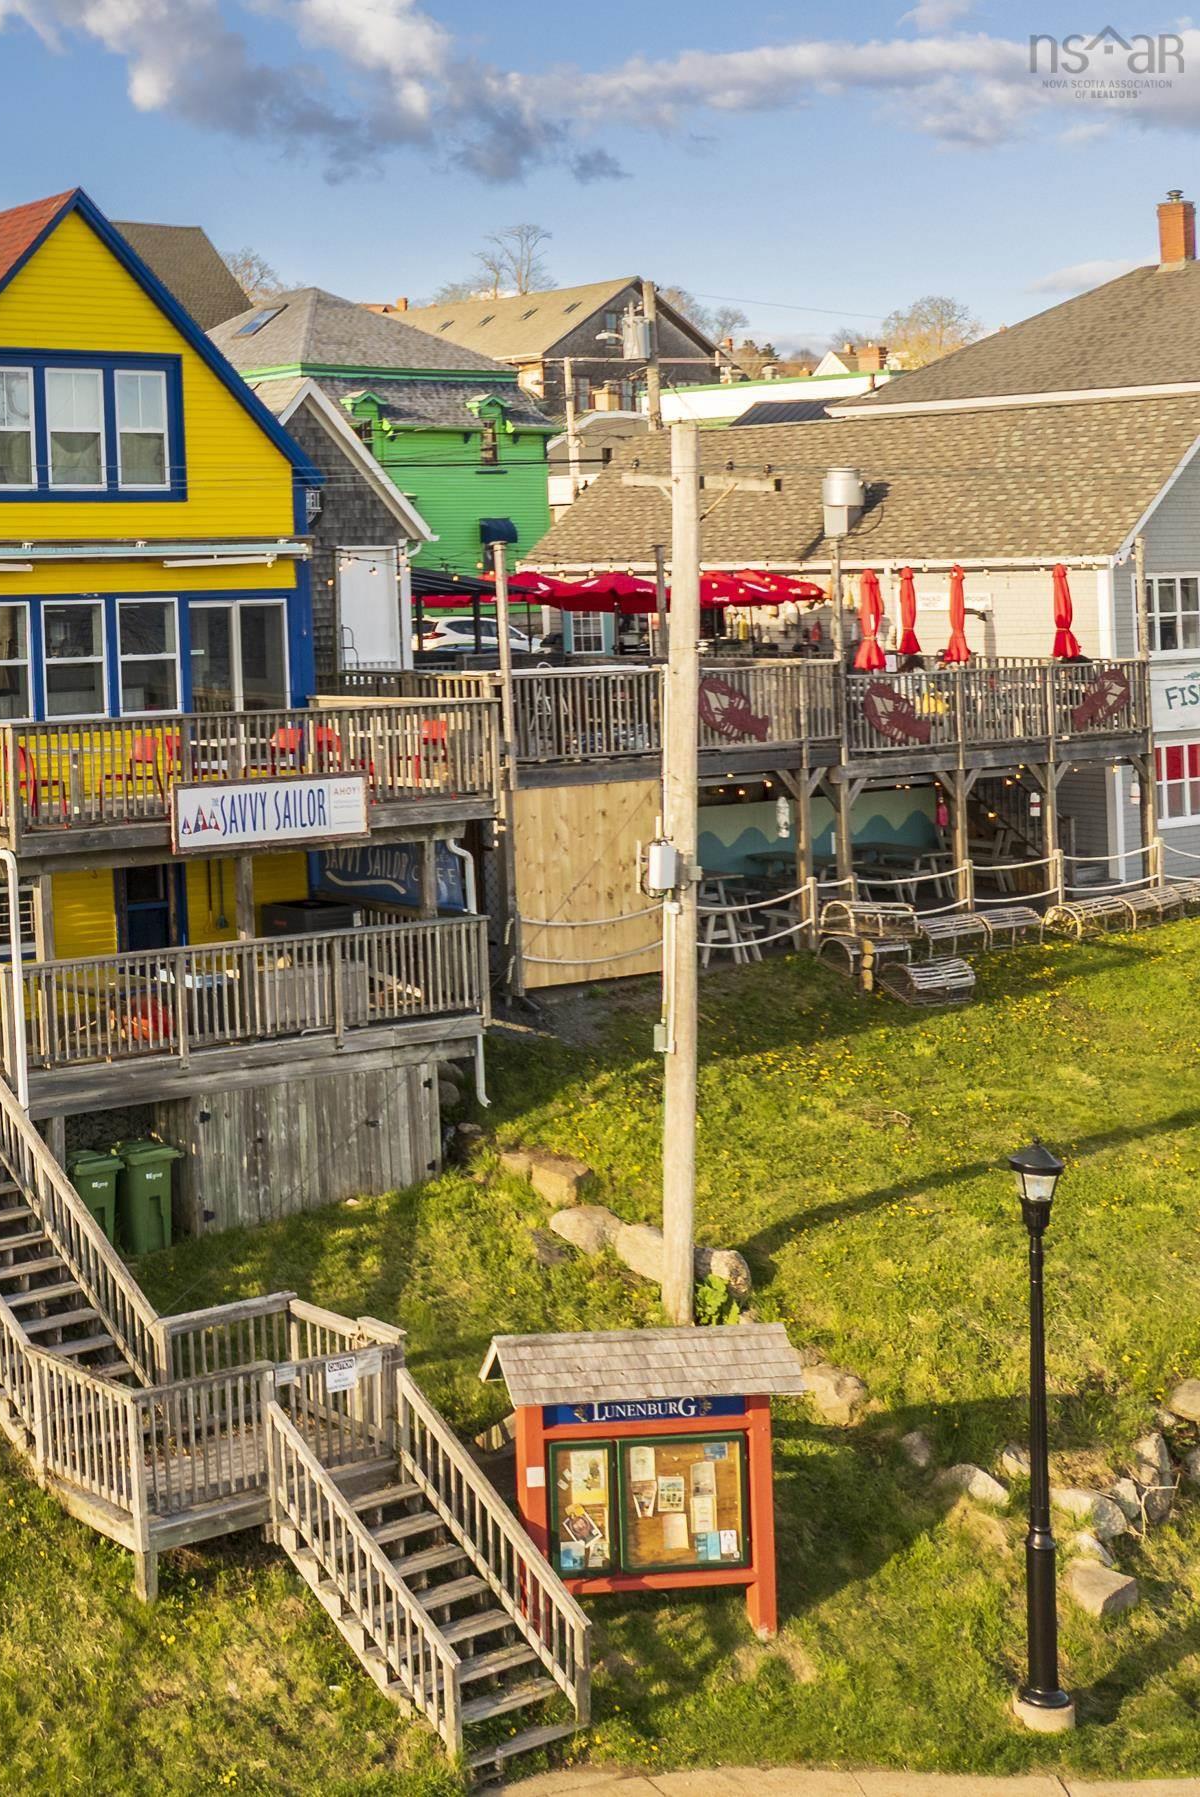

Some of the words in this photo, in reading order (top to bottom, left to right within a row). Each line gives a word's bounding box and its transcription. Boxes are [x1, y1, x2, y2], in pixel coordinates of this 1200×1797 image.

[1165, 684, 1200, 710] FIS
[220, 791, 267, 836] SAVVY
[274, 788, 327, 831] SAILOR
[324, 847, 362, 874] SAVVY
[592, 1396, 698, 1421] LUNENBURG
